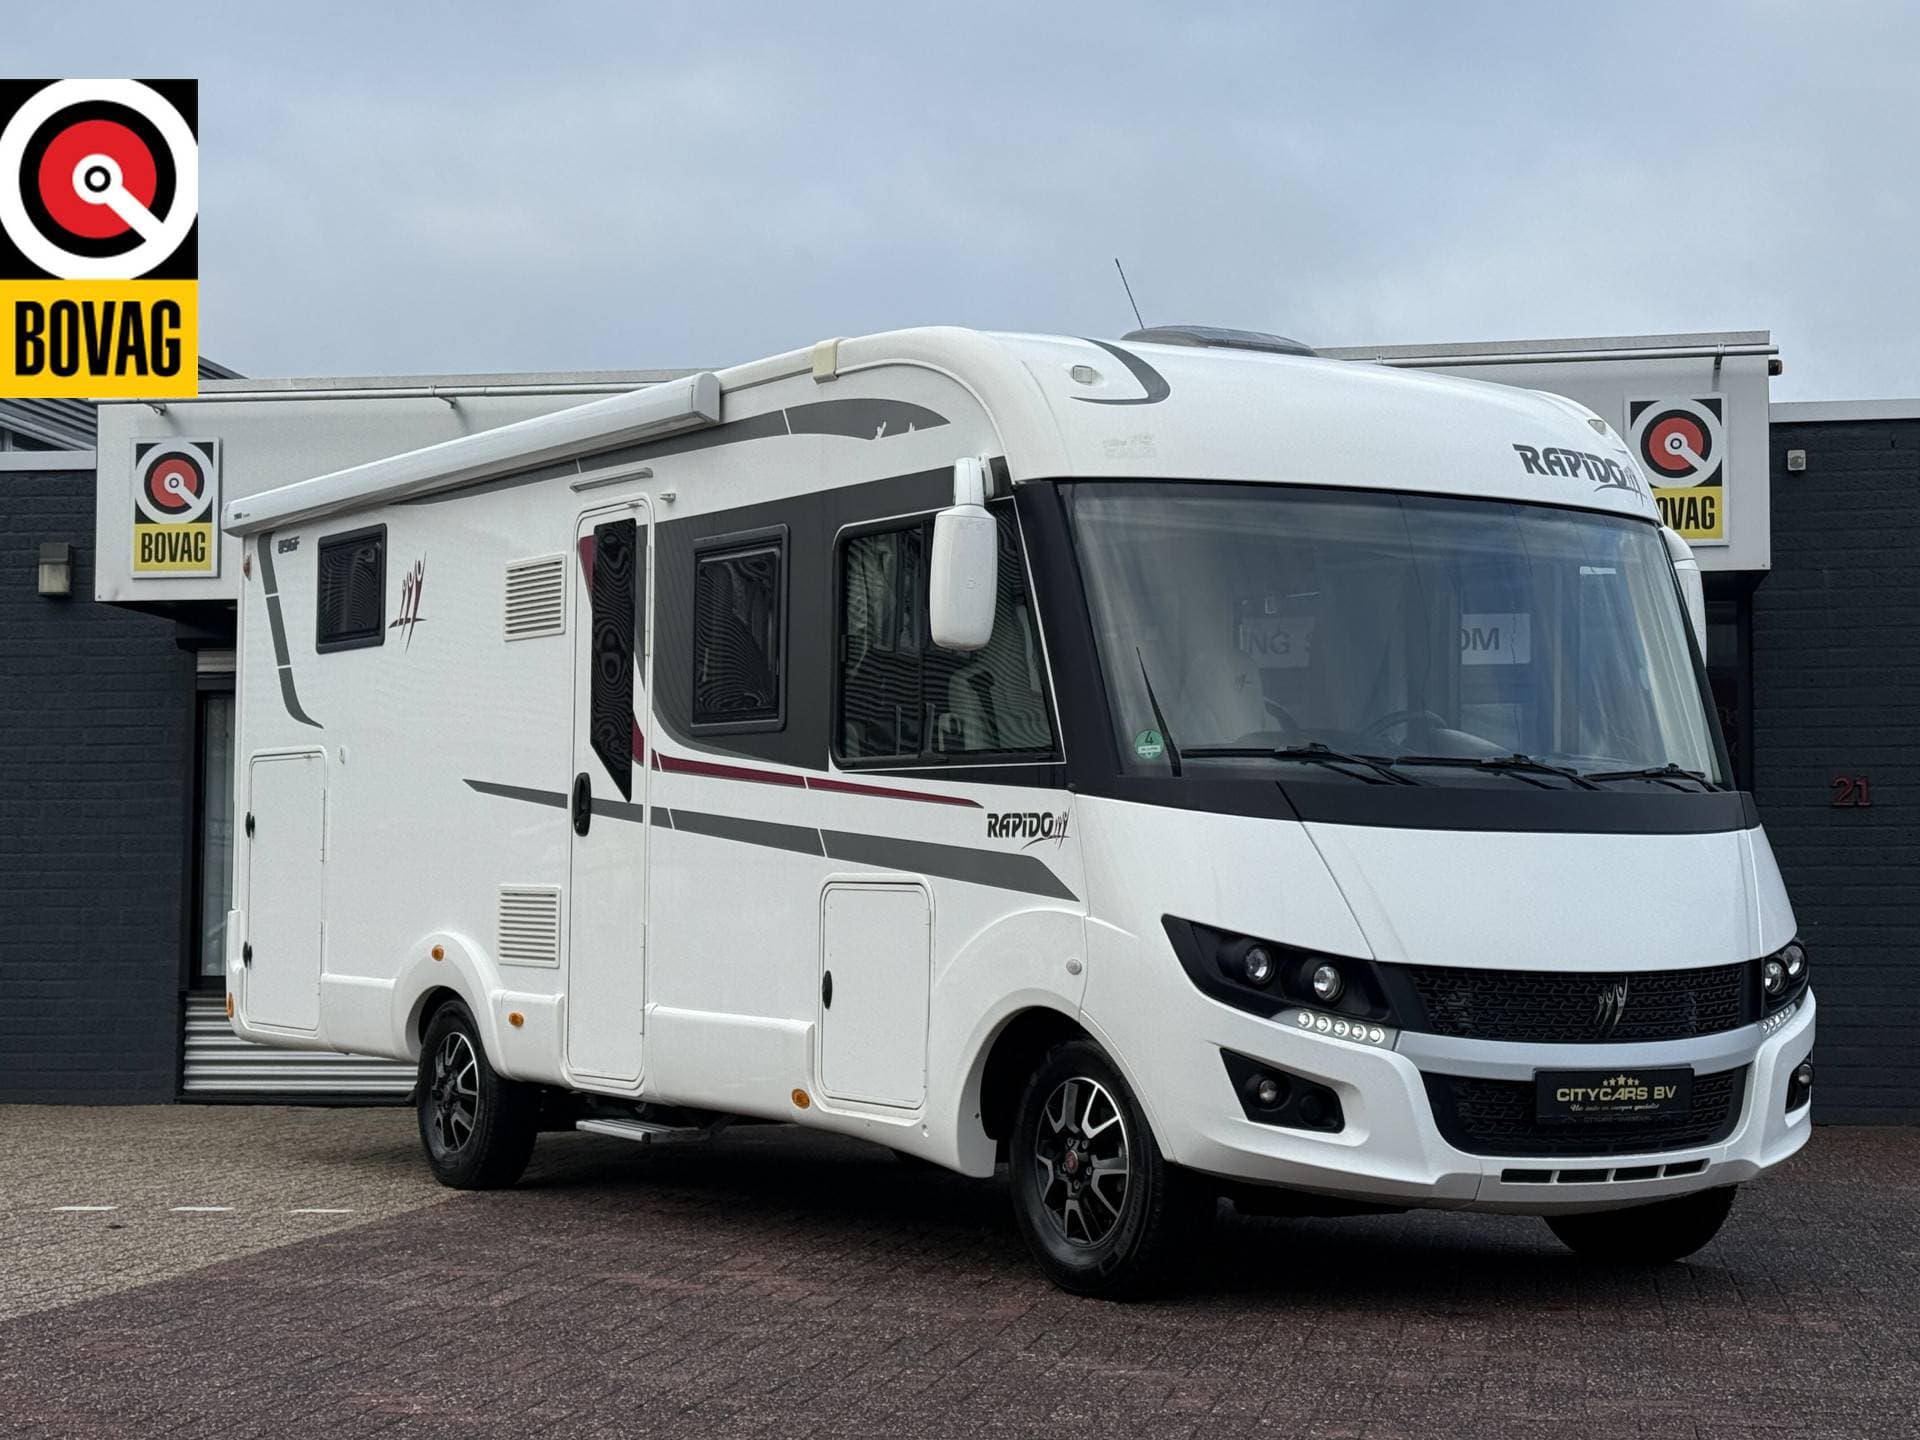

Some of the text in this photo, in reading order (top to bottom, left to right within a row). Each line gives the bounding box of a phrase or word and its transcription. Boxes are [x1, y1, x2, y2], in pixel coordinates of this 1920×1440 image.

[1657, 495, 1715, 530] OVAG
[140, 531, 206, 563] BOVAG
[1145, 731, 1154, 745] 4
[1831, 776, 1872, 806] 21
[1556, 1085, 1677, 1102] CITYCARS BV
